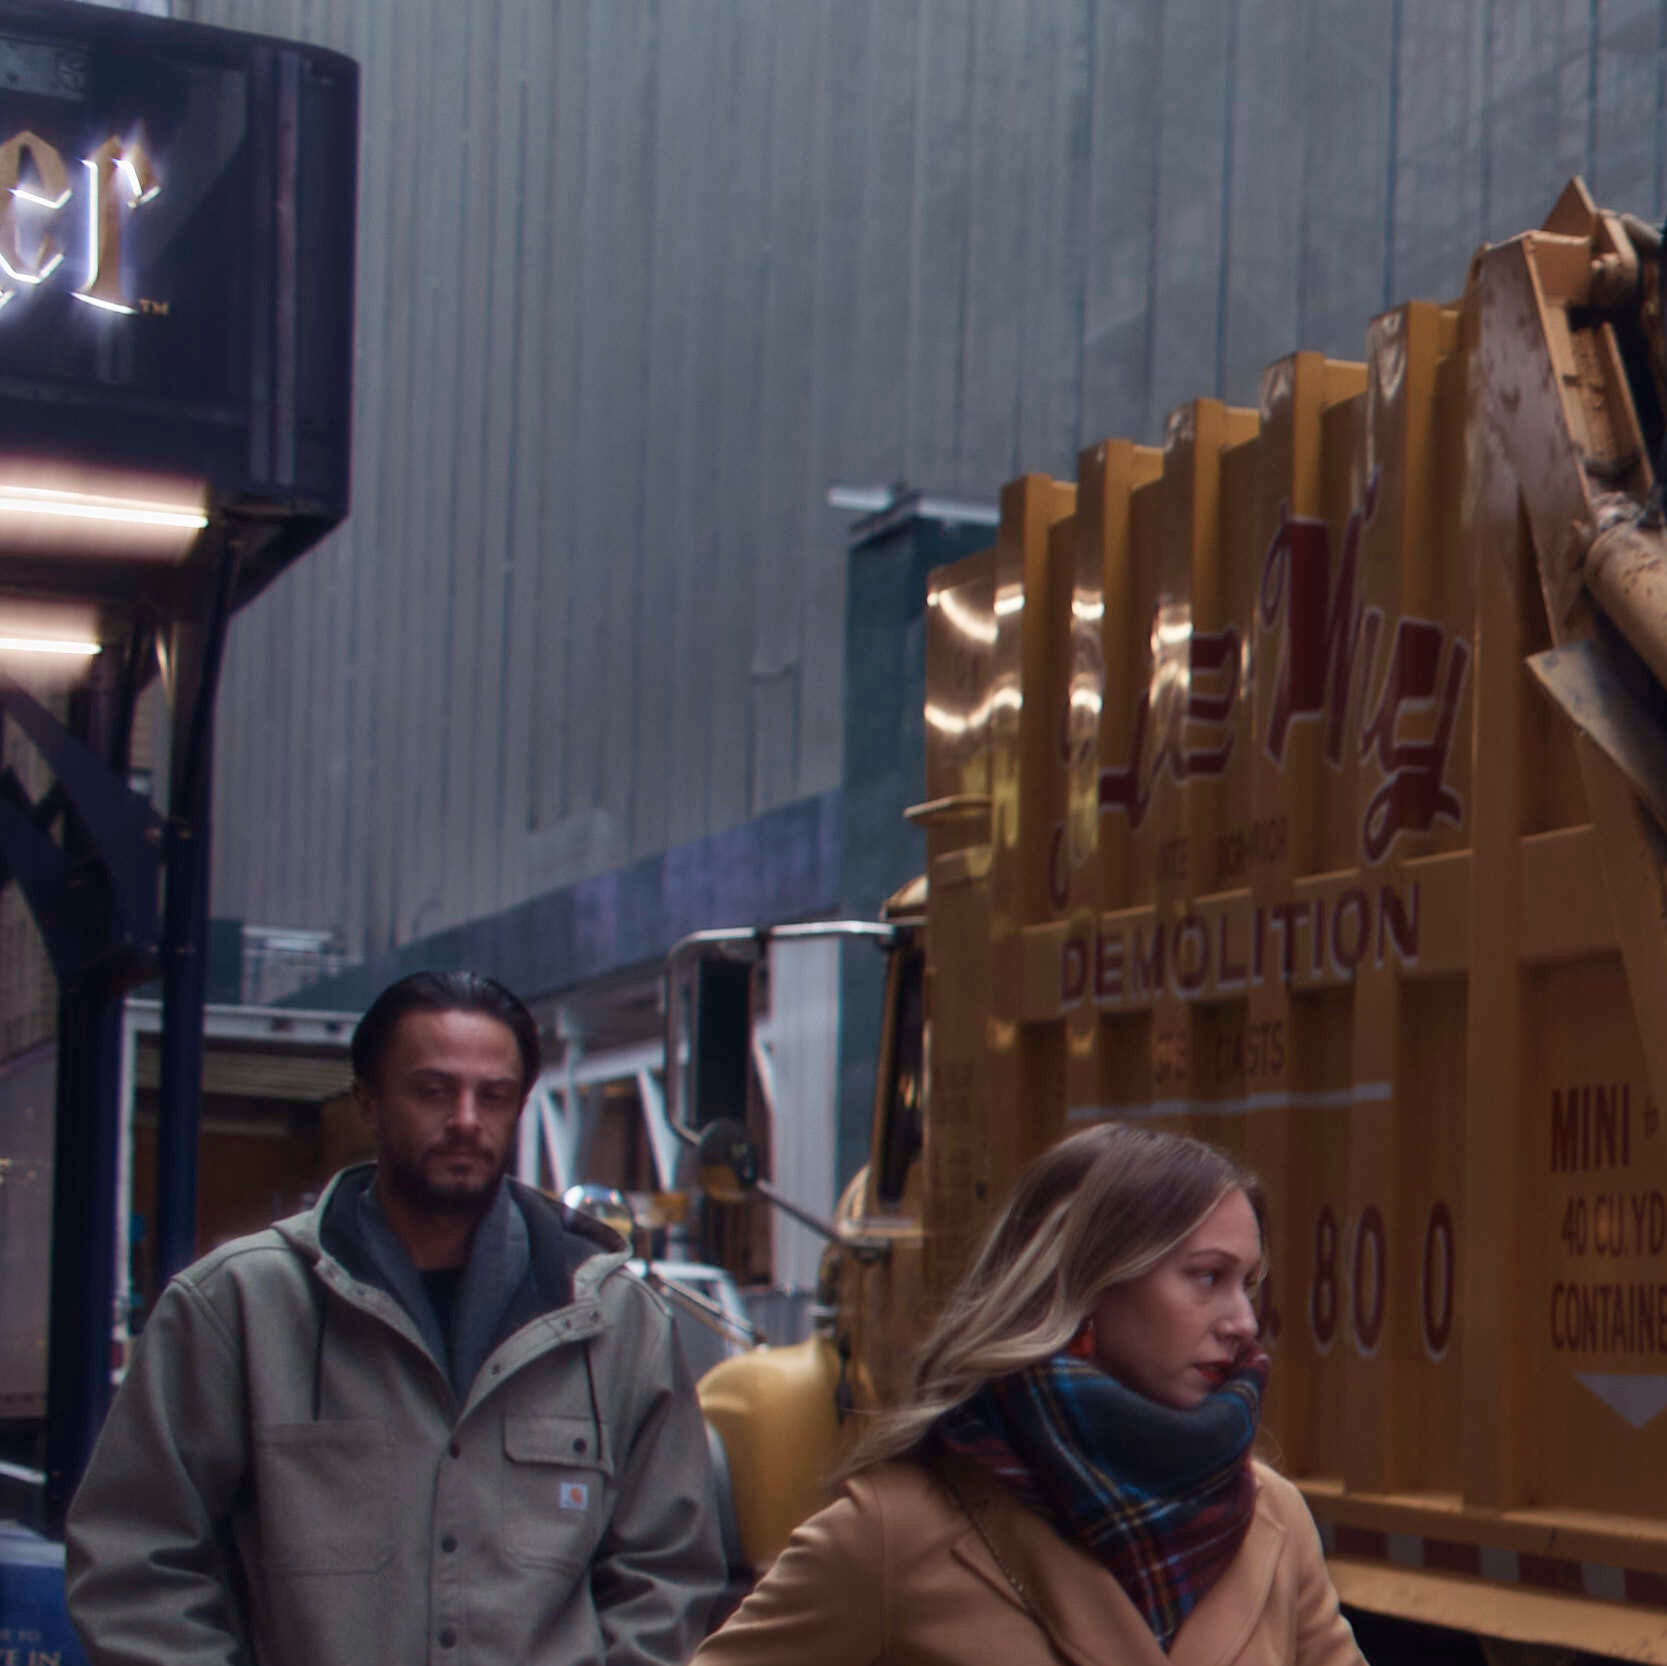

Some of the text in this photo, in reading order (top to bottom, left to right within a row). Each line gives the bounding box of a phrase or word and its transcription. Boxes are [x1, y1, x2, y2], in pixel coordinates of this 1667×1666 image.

[0, 130, 163, 315] er
[1059, 880, 1420, 1010] DEMOLITION
[1551, 1083, 1631, 1173] MINI
